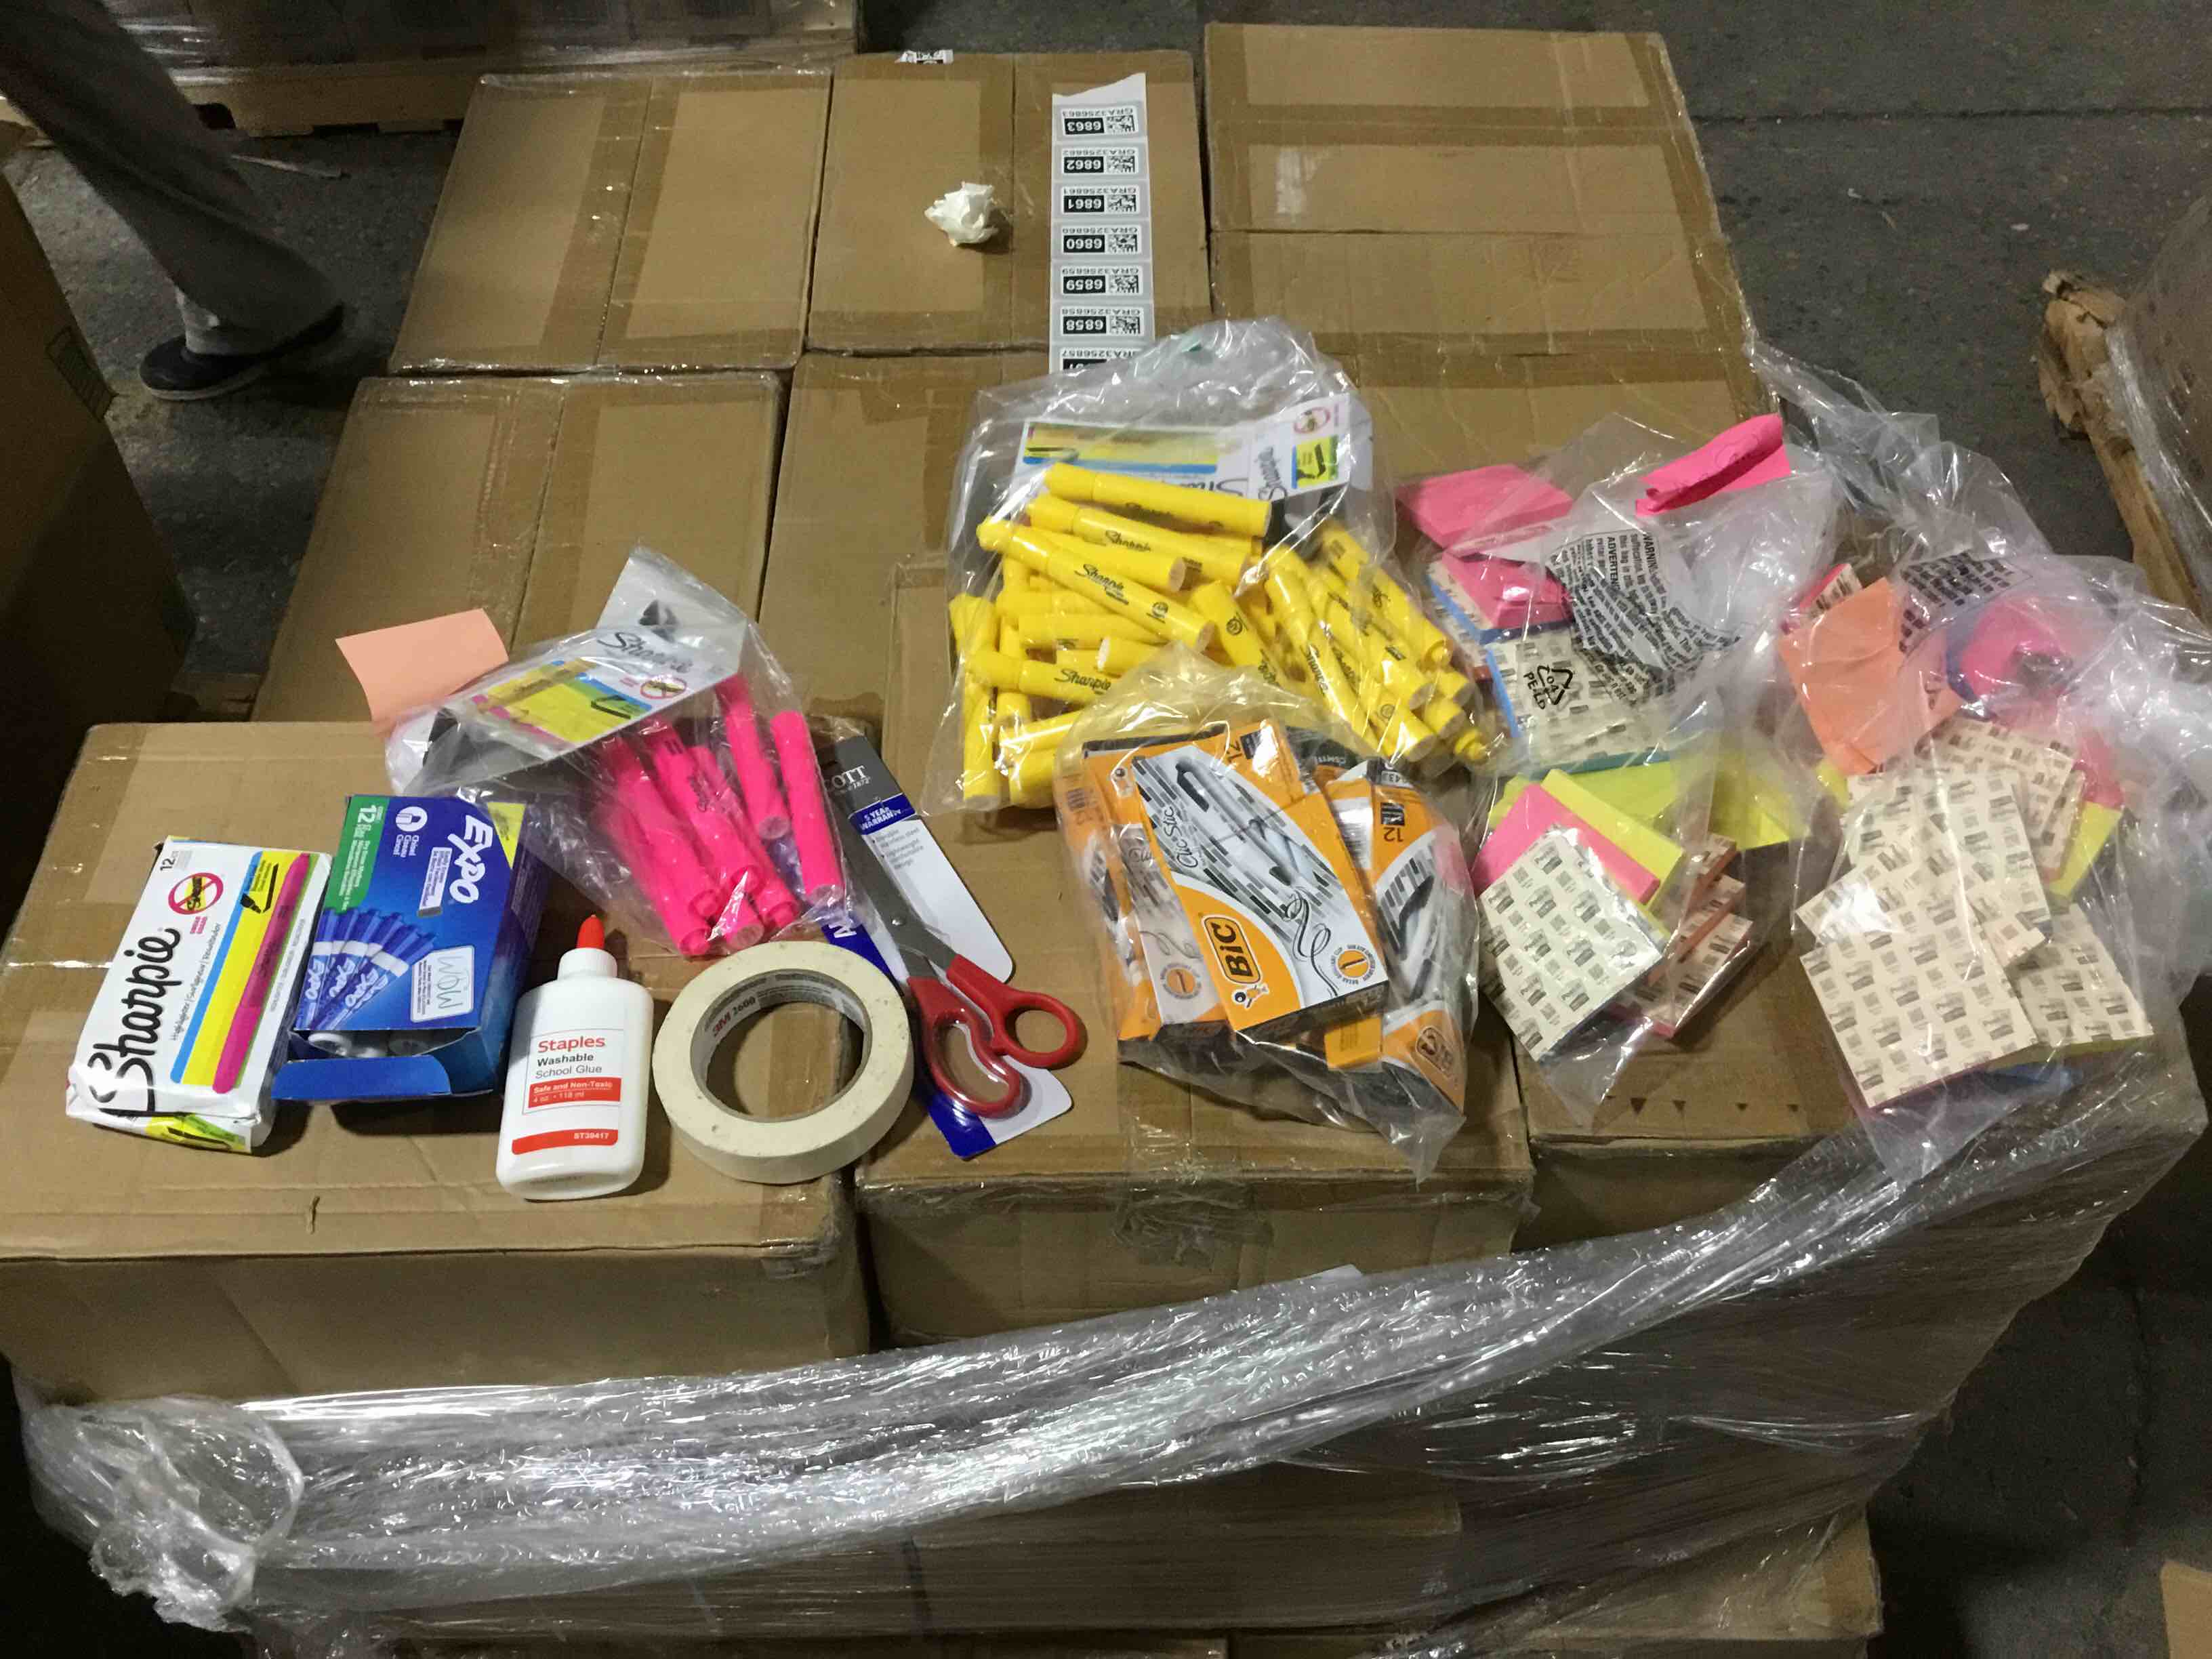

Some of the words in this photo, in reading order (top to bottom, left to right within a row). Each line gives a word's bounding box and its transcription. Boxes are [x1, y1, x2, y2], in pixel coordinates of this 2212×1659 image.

[1067, 121, 1101, 131] 6863
[1067, 159, 1101, 169] 6862
[1068, 199, 1101, 209] 6861
[1066, 239, 1102, 249] 6860
[1066, 279, 1103, 290] 6859
[1066, 320, 1103, 331] 6858
[1055, 668, 1112, 691] Sharpie
[1547, 676, 1559, 692] 04
[826, 764, 865, 792] COTT
[358, 804, 377, 823] 12
[861, 808, 901, 830] WARRANTY
[872, 806, 893, 819] YEAR
[1164, 806, 1182, 837] Stic
[1383, 827, 1404, 842] 12
[1176, 840, 1199, 868] Clic
[160, 857, 176, 871] 12
[88, 927, 183, 1115] Sharpie
[713, 1012, 732, 1038] 3M
[537, 1036, 606, 1053] Staples
[537, 1053, 594, 1067] Washable
[535, 1066, 572, 1079] School
[575, 1064, 602, 1074] Glue
[533, 1085, 551, 1094] Safe
[570, 1080, 613, 1088] Non-Toxic
